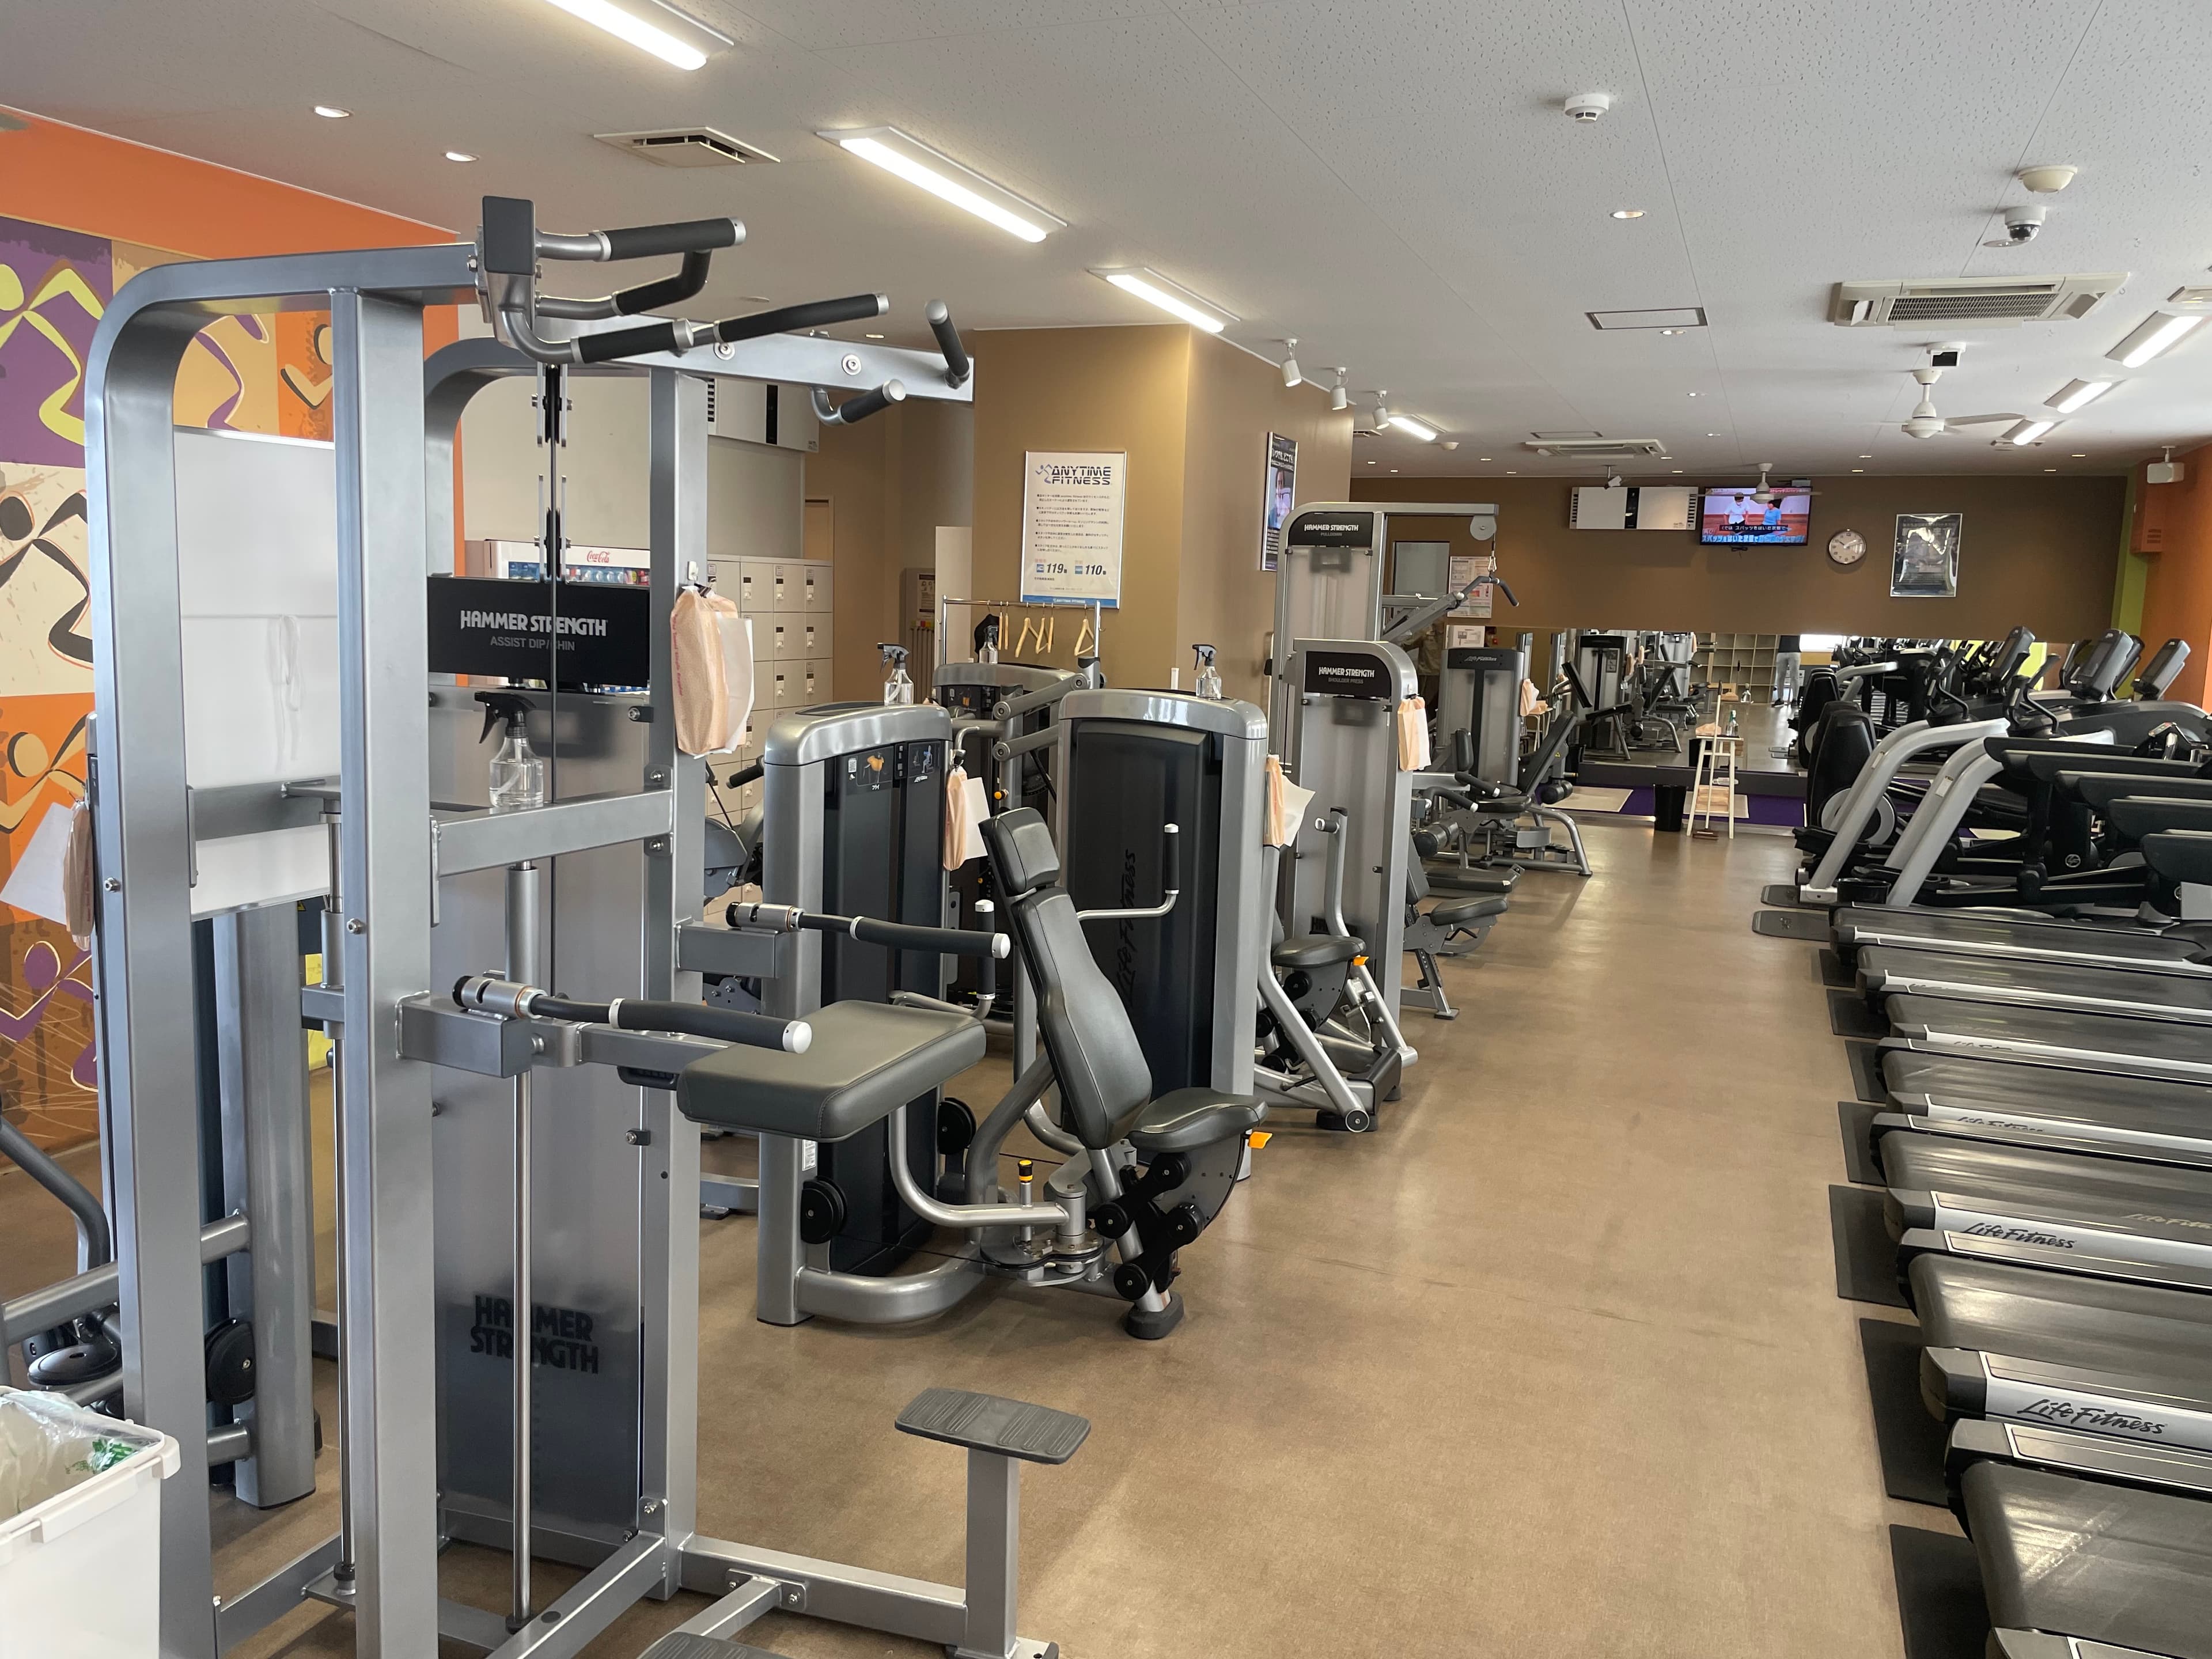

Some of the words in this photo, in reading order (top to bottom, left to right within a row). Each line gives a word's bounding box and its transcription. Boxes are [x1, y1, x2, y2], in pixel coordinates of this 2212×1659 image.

[1051, 465, 1111, 476] ANYTIME
[1051, 476, 1111, 485] FITNESS
[461, 610, 528, 631] HAMMER
[530, 615, 607, 637] STRENGTH
[490, 636, 527, 648] ASSIST
[528, 638, 575, 651] DIP/HIN
[1319, 666, 1344, 676] HAMMER
[1345, 668, 1375, 677] STRENGTH
[475, 1294, 593, 1342] HAMER
[471, 1325, 599, 1374] STRNGTH
